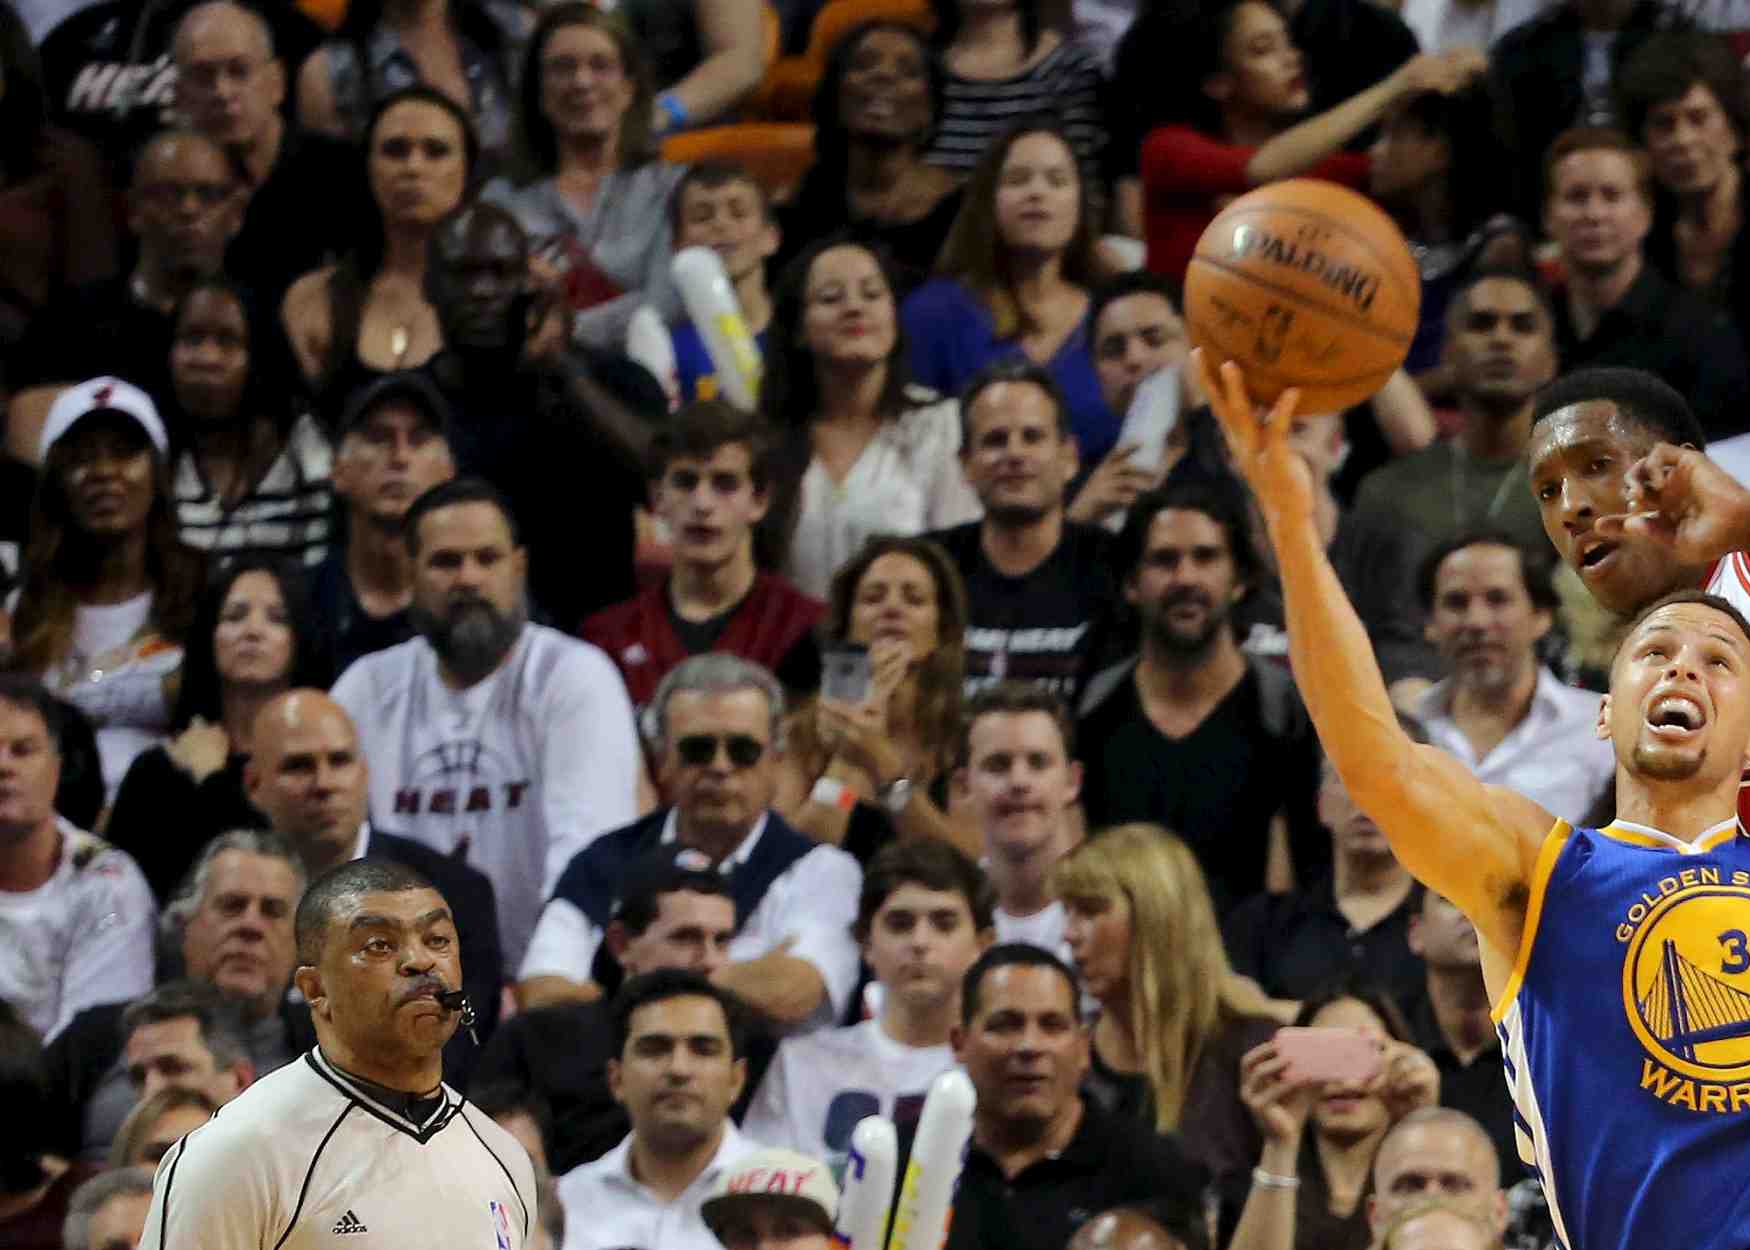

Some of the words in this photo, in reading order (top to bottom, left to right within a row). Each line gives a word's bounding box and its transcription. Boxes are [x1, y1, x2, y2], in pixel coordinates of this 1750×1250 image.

[1246, 228, 1382, 316] PALDING
[394, 778, 531, 815] HEAT
[1616, 866, 1720, 944] GOLDEN
